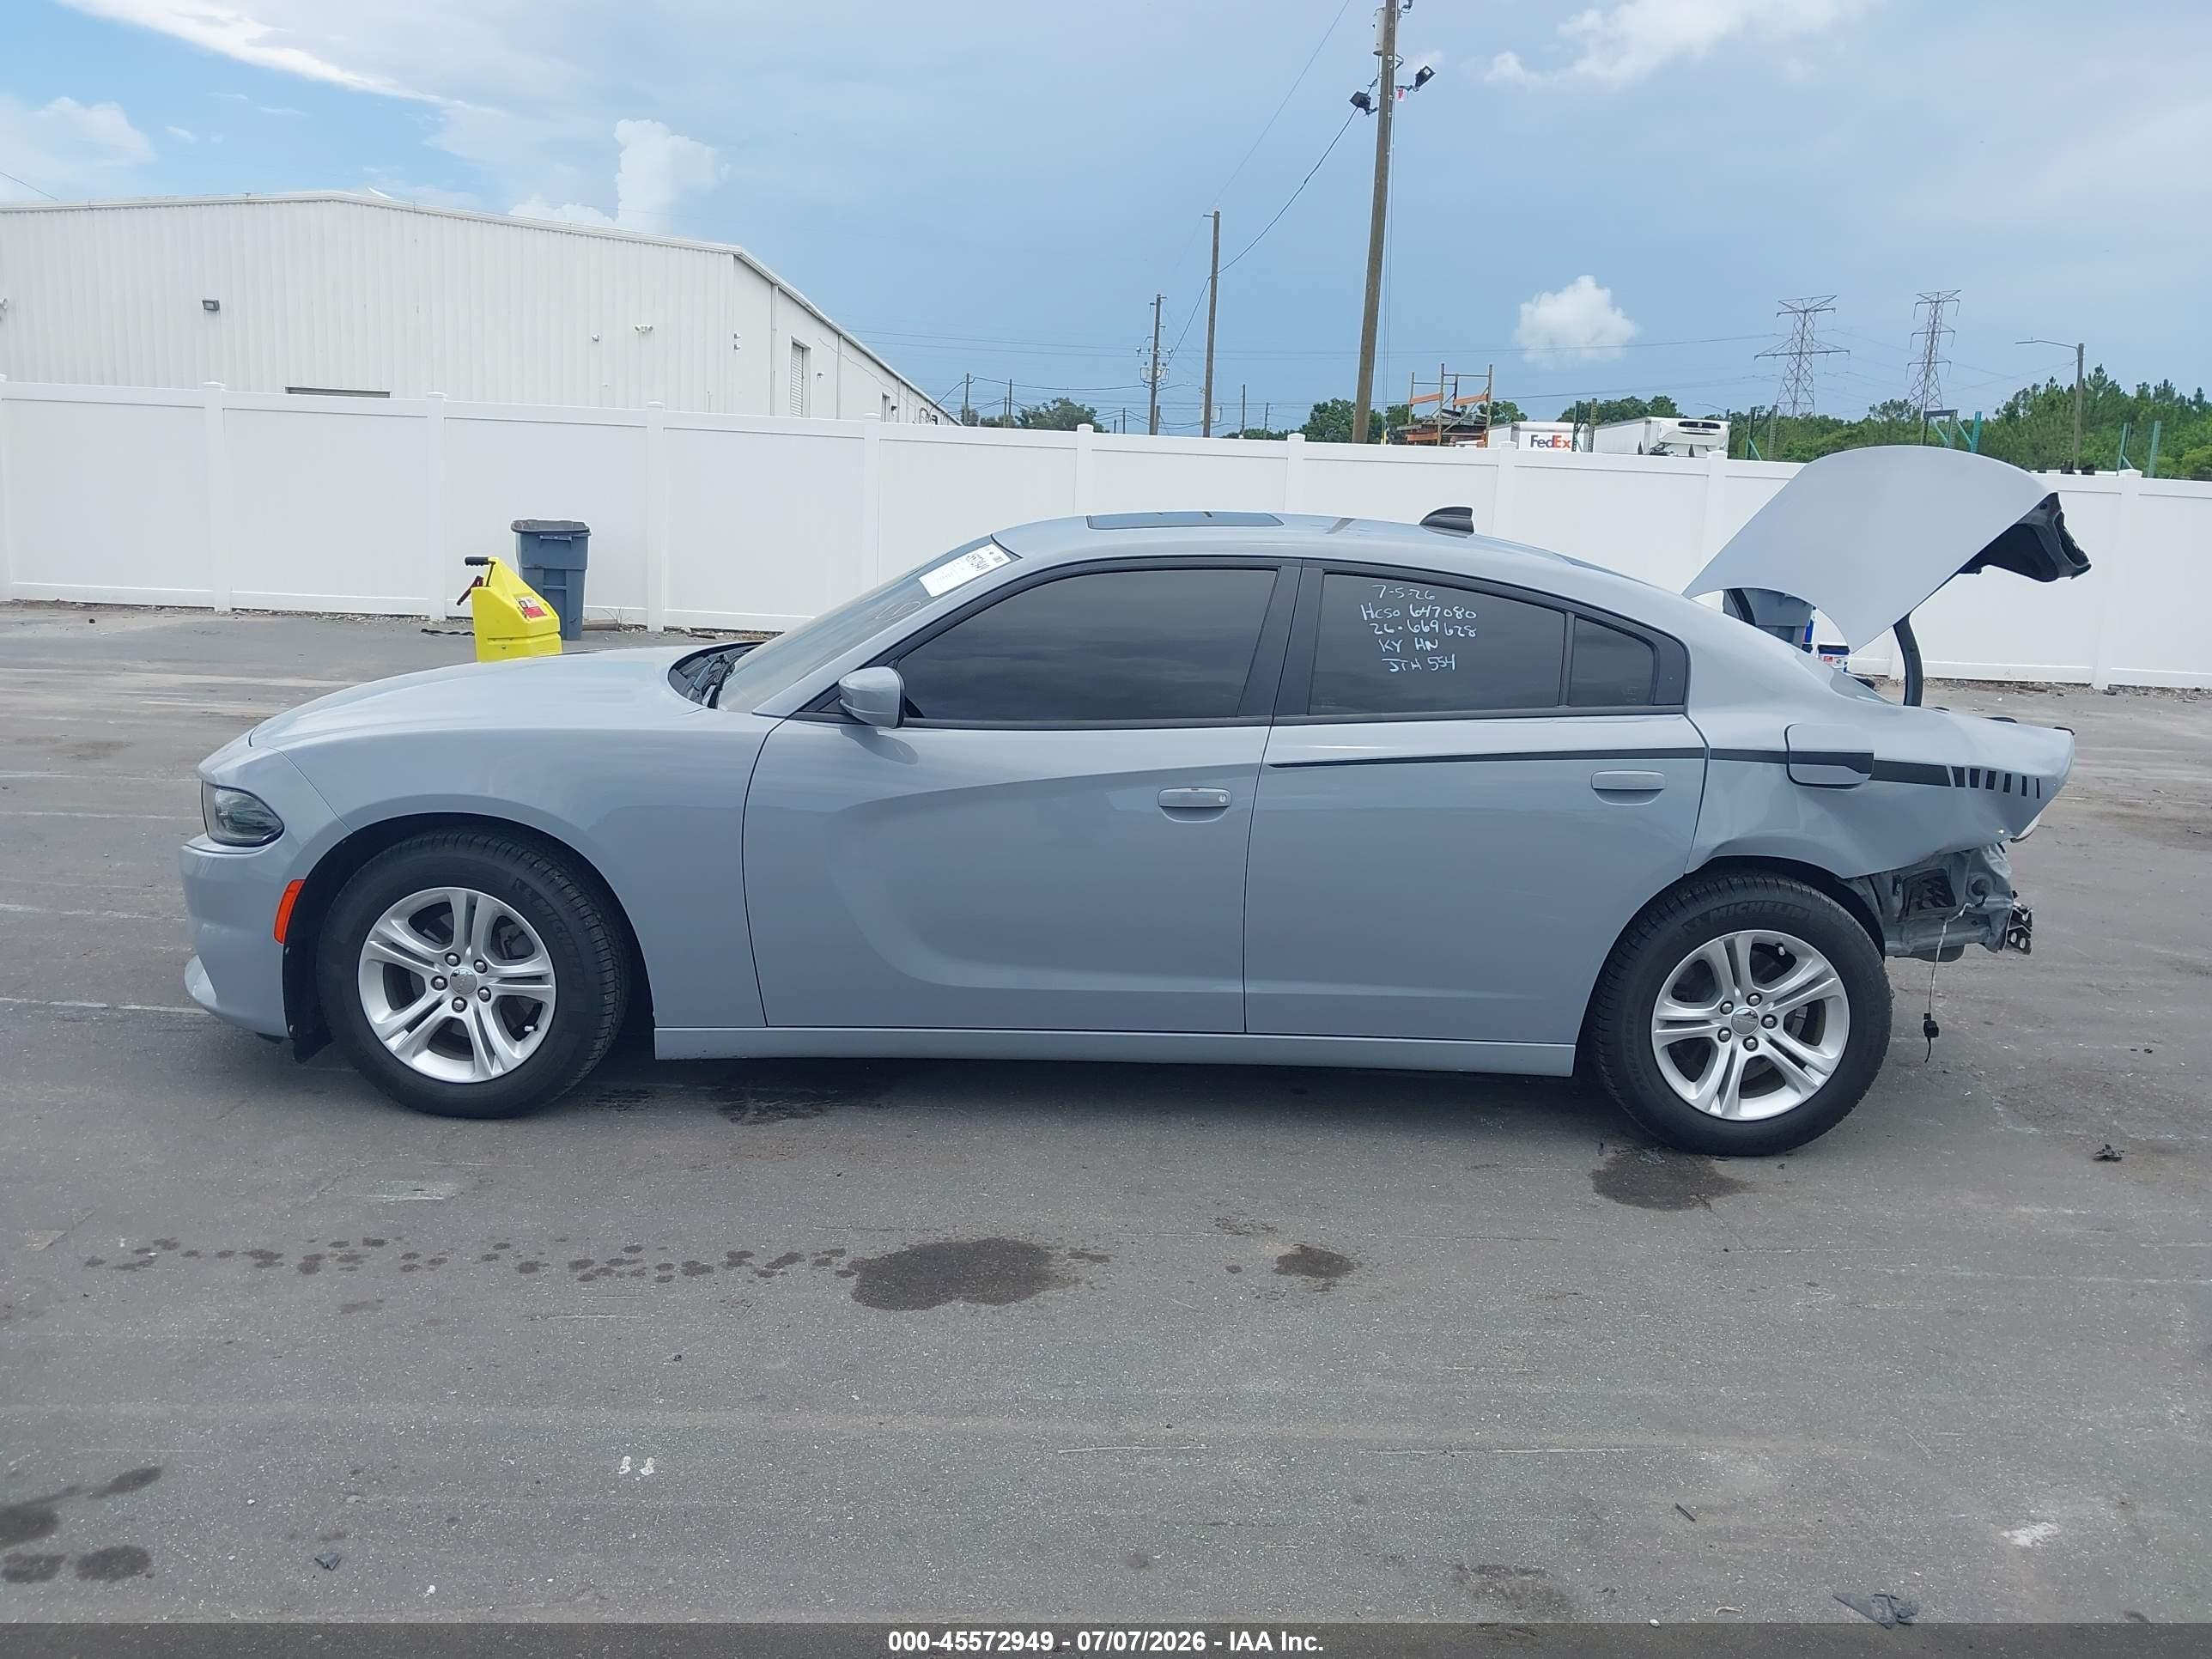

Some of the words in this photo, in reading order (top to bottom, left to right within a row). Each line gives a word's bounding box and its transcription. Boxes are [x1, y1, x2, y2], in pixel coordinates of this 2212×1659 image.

[1529, 434, 1571, 448] FedEx
[1409, 604, 1477, 619] 647080
[1378, 638, 1403, 653] KY
[1427, 653, 1455, 671] 554
